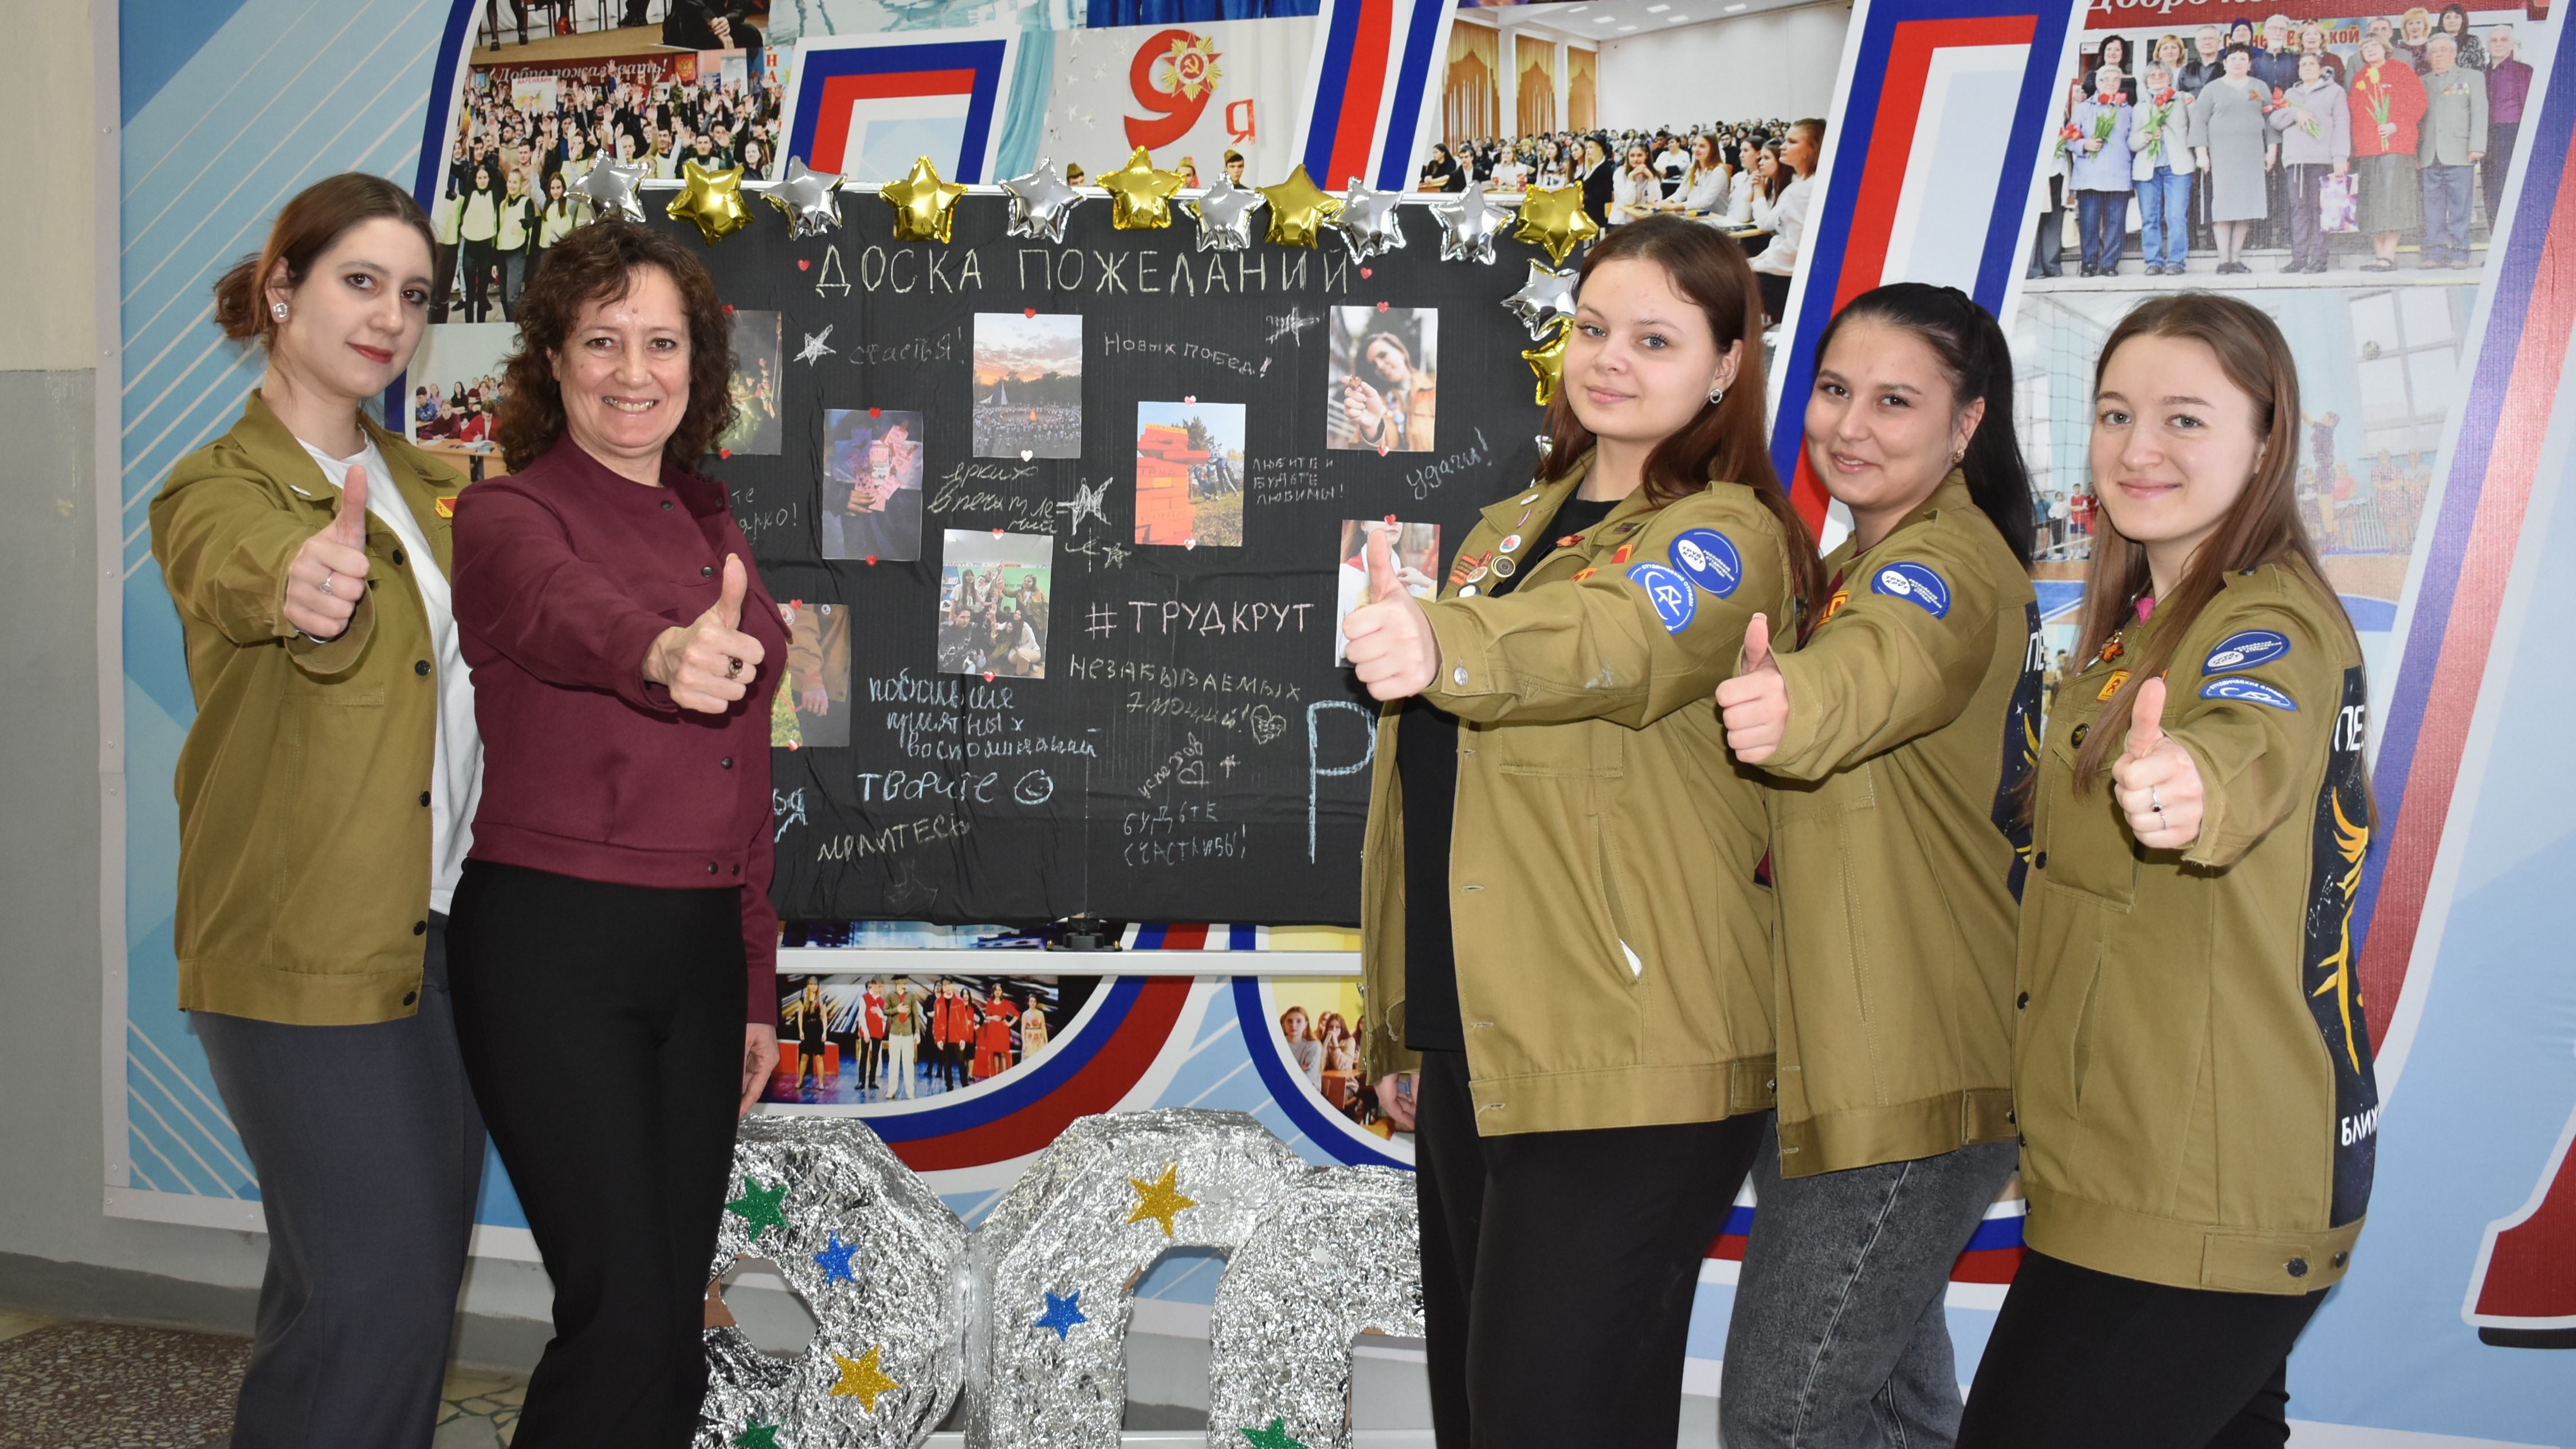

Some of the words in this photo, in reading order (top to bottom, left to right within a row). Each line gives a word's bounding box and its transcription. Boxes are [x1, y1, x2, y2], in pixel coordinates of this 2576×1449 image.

[2286, 25, 2360, 47] ВКОЙ
[816, 244, 982, 298] ДОСКА
[1018, 248, 1348, 297] ПОЖЕЛАНИЙ
